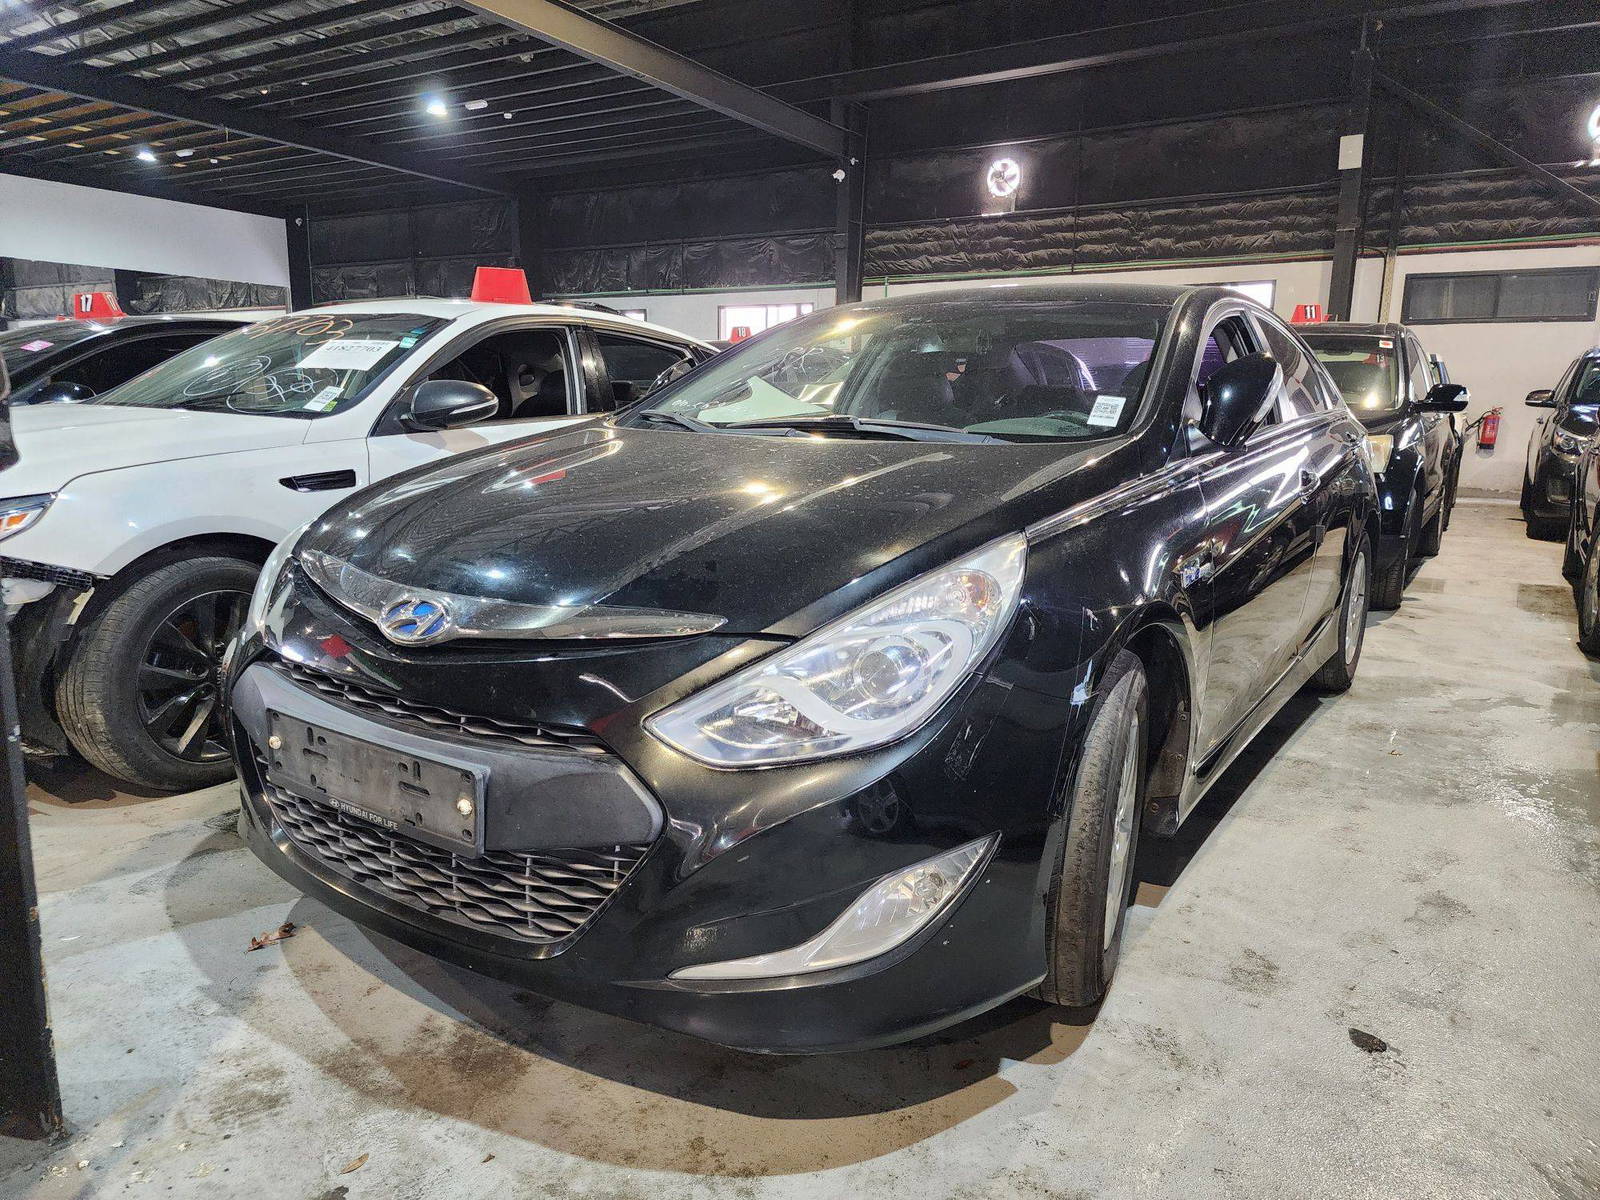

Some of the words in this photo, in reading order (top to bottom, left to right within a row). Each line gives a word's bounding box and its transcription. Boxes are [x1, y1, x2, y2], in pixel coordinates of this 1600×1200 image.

[80, 294, 93, 312] 17
[1304, 304, 1316, 319] 11
[737, 327, 747, 337] 18
[340, 802, 368, 819] HYUNDAI
[369, 813, 383, 825] FOR
[383, 818, 399, 831] LIFE
